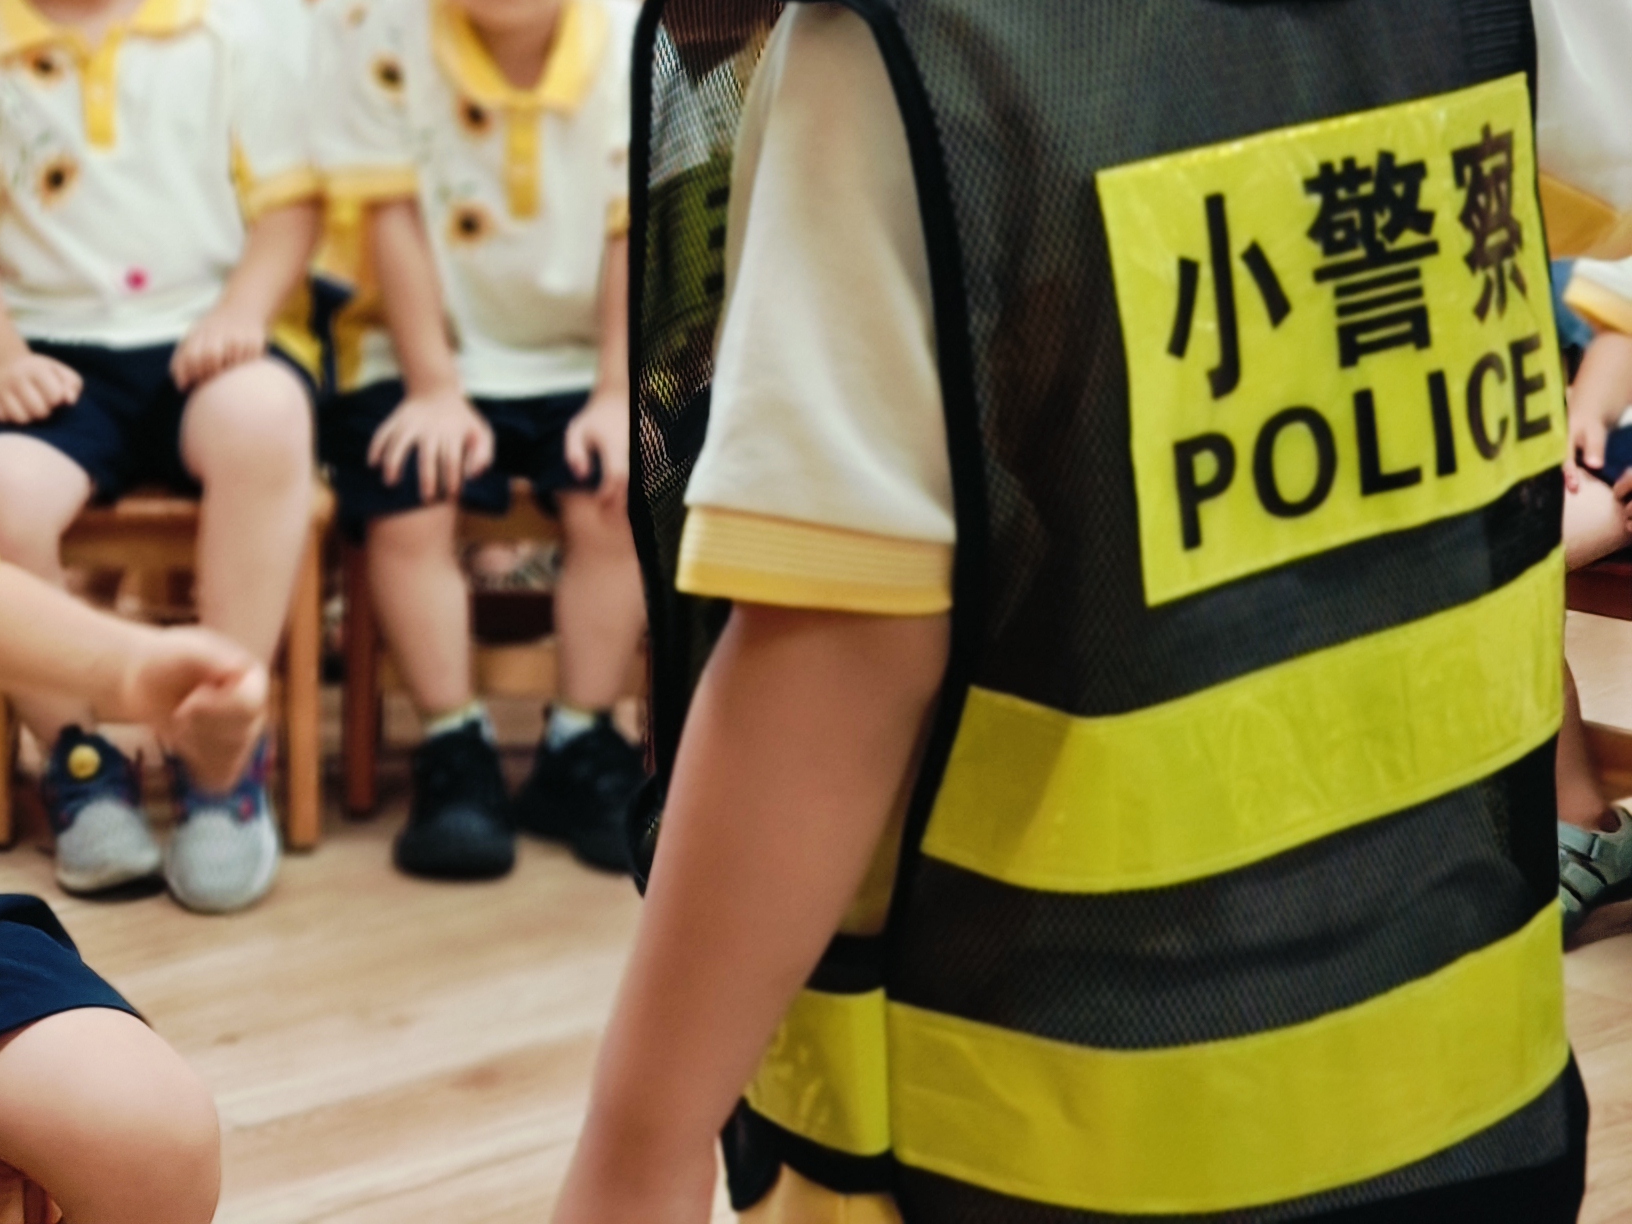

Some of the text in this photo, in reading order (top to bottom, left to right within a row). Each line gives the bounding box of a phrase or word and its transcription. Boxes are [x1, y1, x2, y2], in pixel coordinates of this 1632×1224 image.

[1166, 122, 1528, 401] 小警察
[1172, 332, 1554, 553] POLICE
